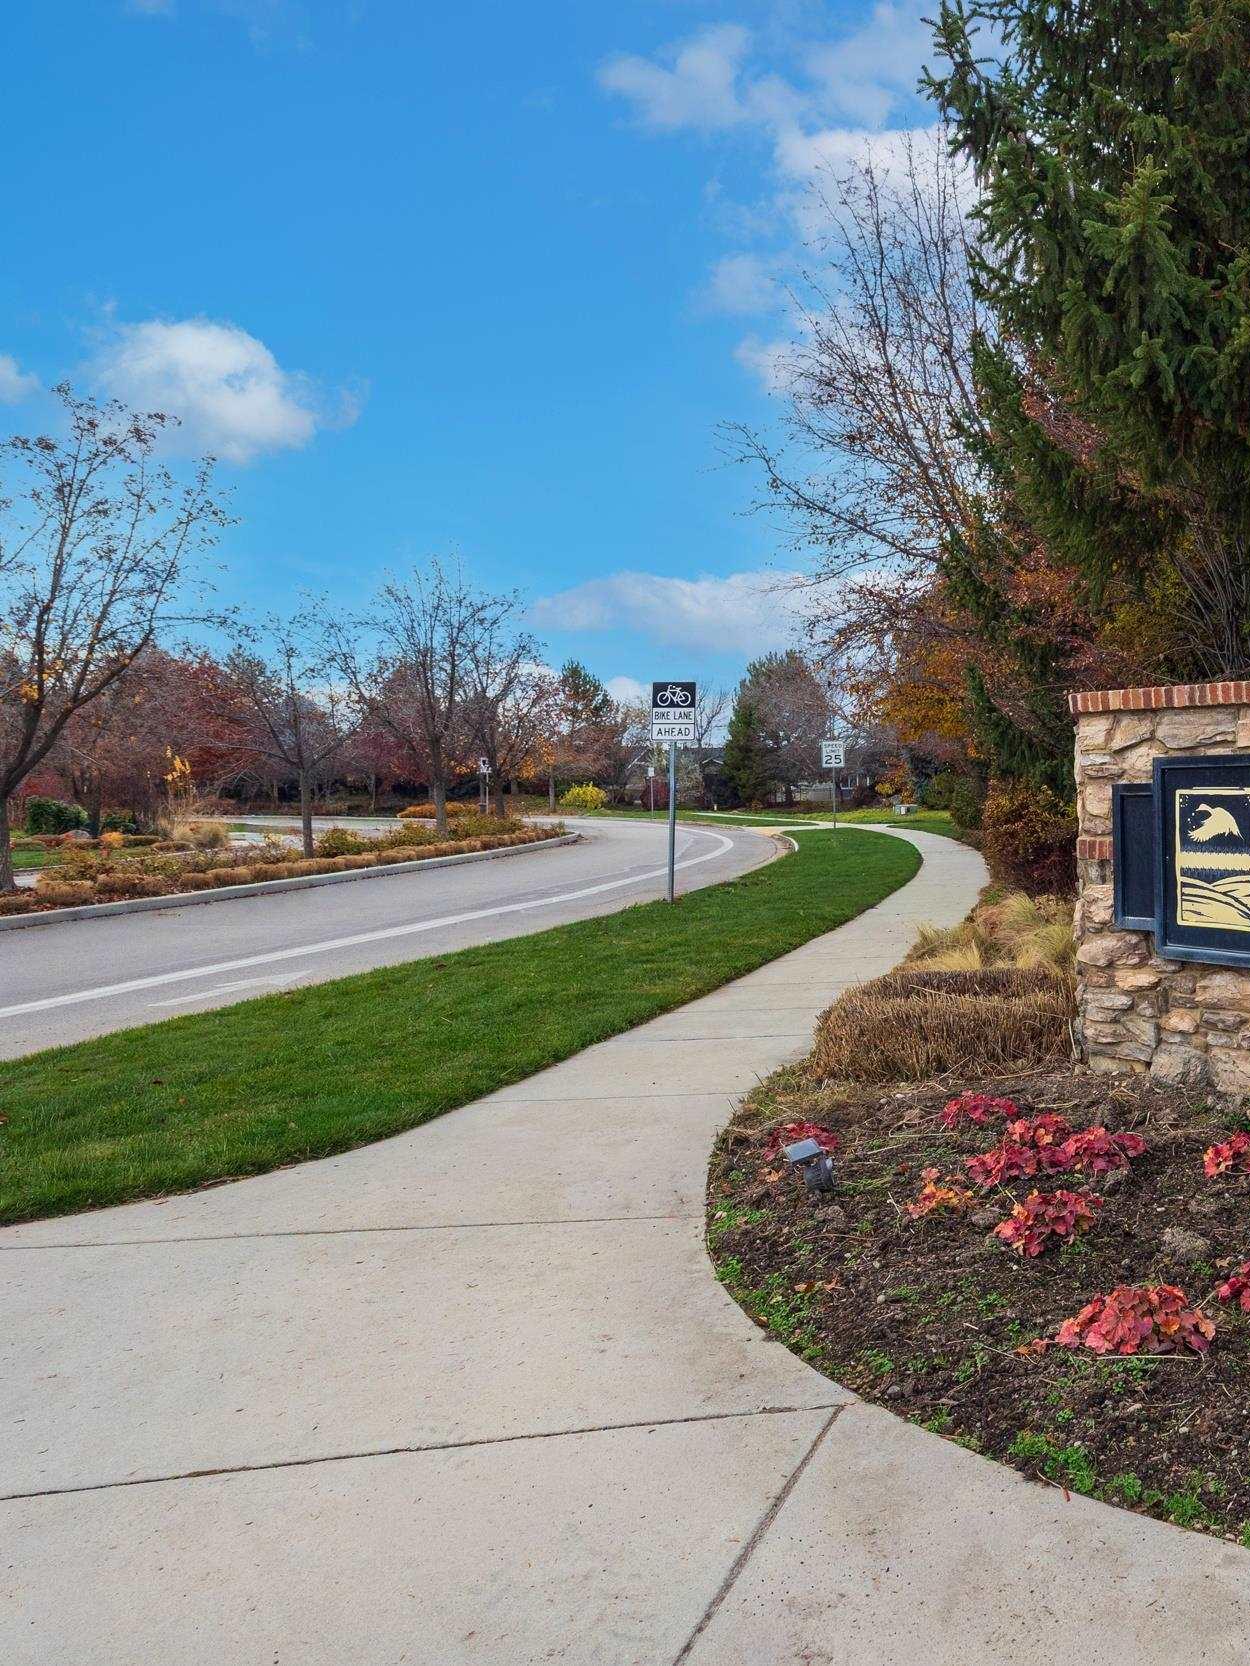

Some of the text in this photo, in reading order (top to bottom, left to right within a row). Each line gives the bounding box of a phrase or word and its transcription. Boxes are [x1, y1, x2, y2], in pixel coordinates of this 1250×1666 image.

[654, 711, 693, 720] BIKE LANE
[656, 727, 690, 736] AHEAD
[824, 754, 842, 764] 25
